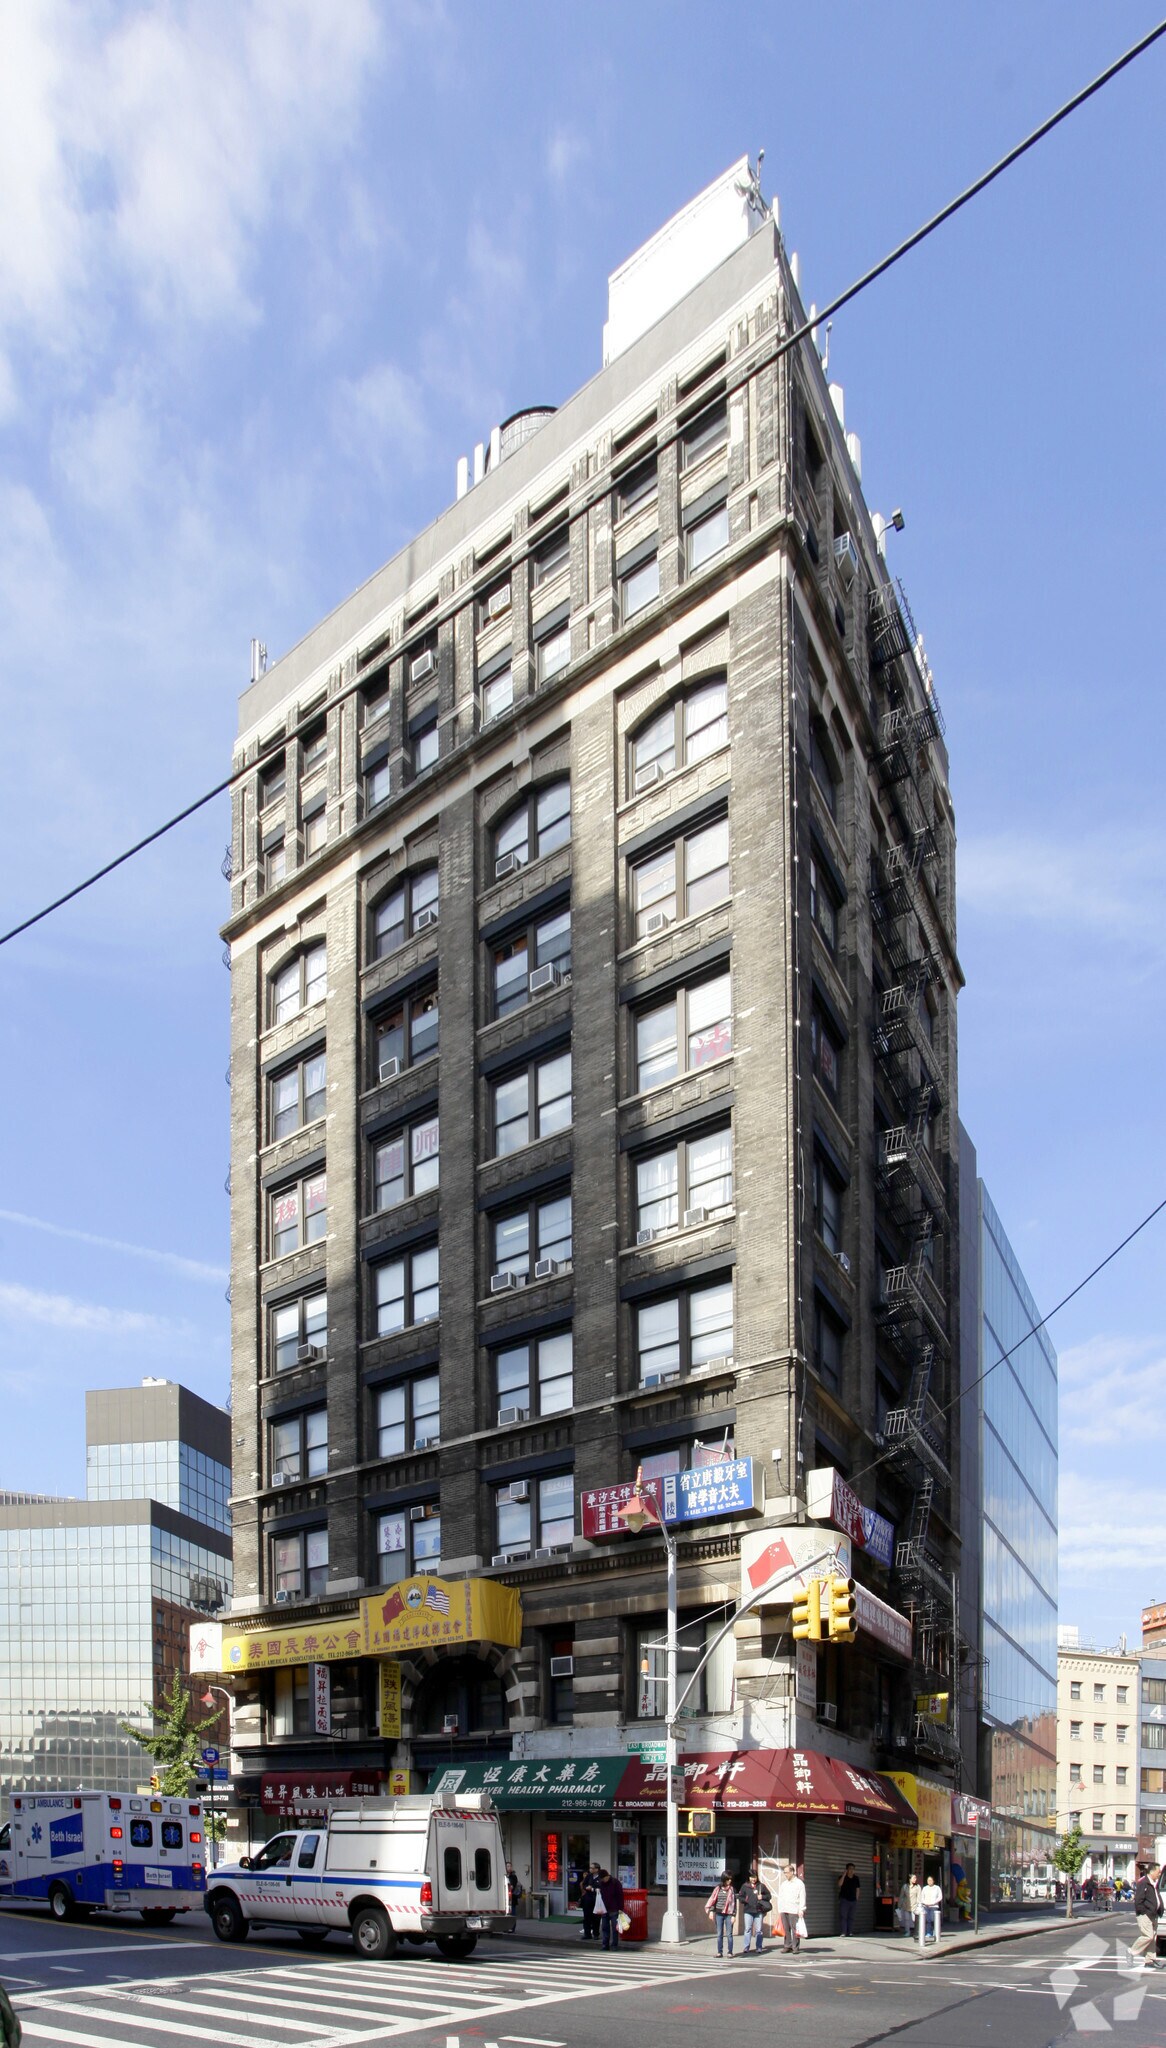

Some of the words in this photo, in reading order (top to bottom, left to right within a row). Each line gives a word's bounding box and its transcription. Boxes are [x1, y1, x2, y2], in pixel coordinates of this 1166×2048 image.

[249, 1629, 361, 1659] 美國長樂公會
[1149, 1704, 1164, 1721] 4
[507, 1785, 545, 1795] HEALTH
[547, 1784, 607, 1794] PHARMACY
[37, 1799, 65, 1808] AMBULANCE
[50, 1830, 65, 1842] Beth
[65, 1830, 83, 1843] Israel
[685, 1838, 700, 1858] FOR
[703, 1838, 723, 1858] RENT
[709, 1861, 720, 1869] LLC
